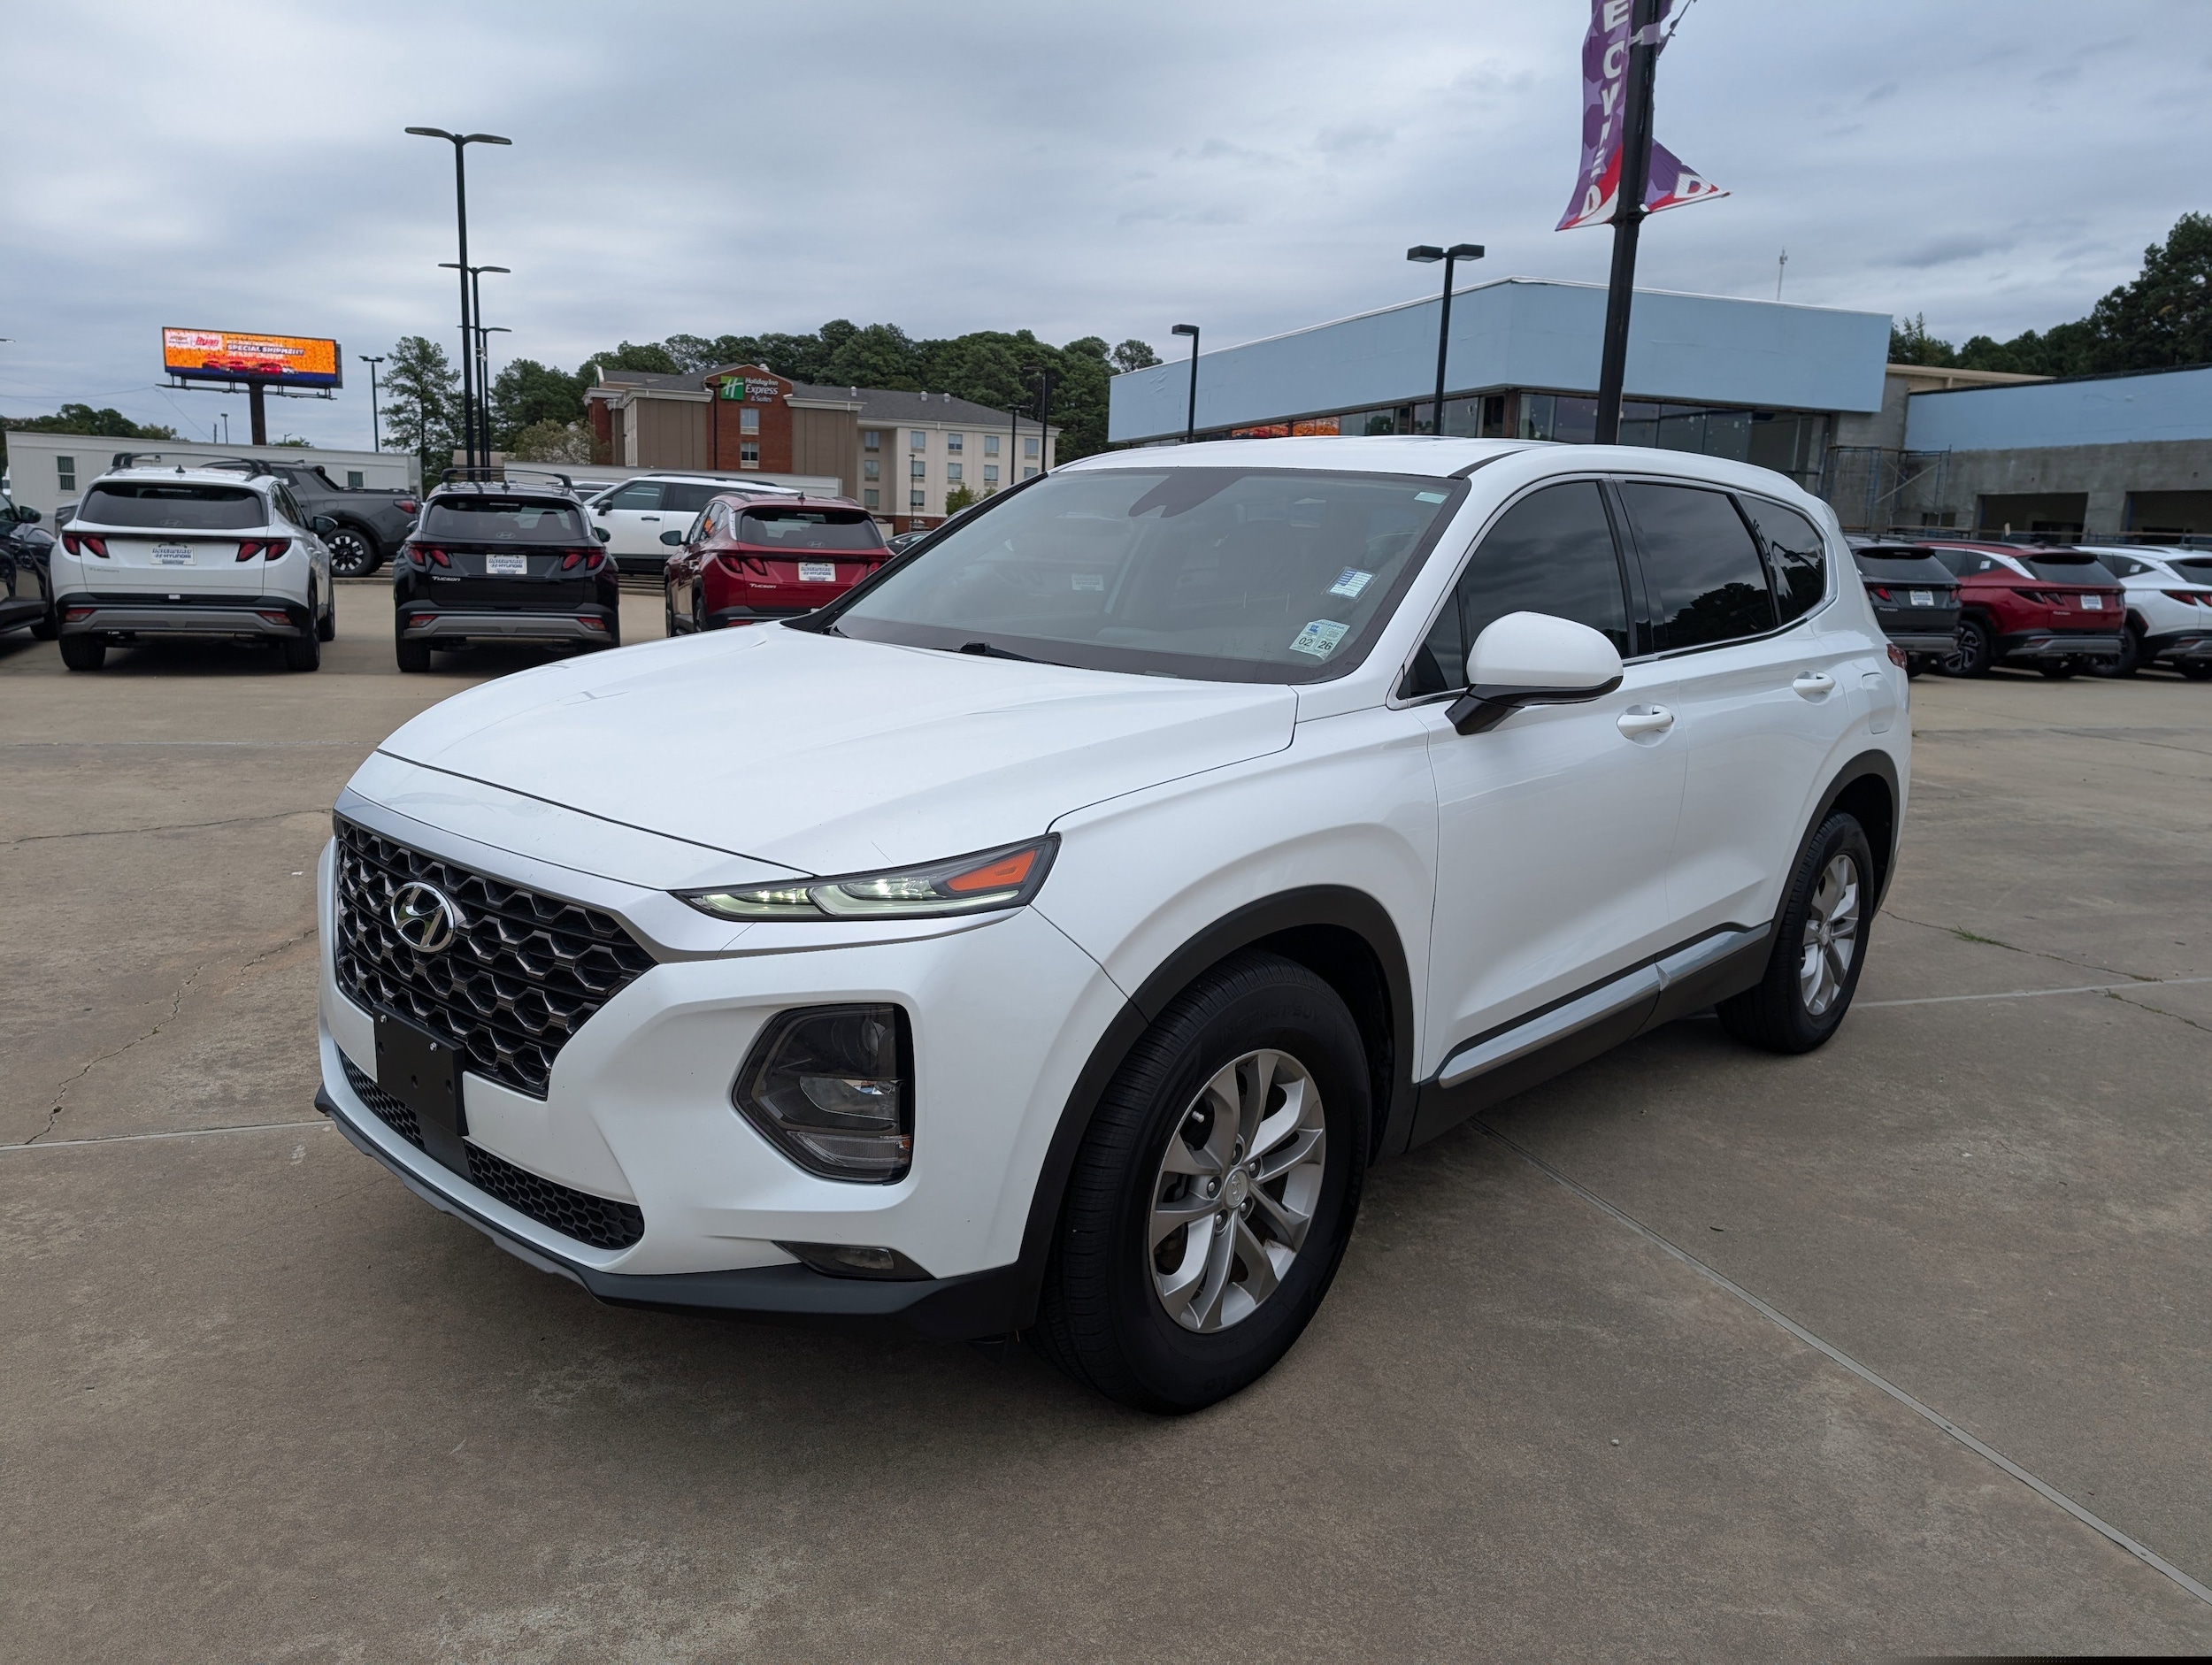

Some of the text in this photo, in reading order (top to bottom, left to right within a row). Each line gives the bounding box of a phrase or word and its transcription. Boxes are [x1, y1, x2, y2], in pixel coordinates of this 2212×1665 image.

[196, 336, 219, 346] Ryan
[745, 377, 769, 386] Holiday
[745, 384, 779, 395] Express
[1298, 637, 1333, 650] 02 26
